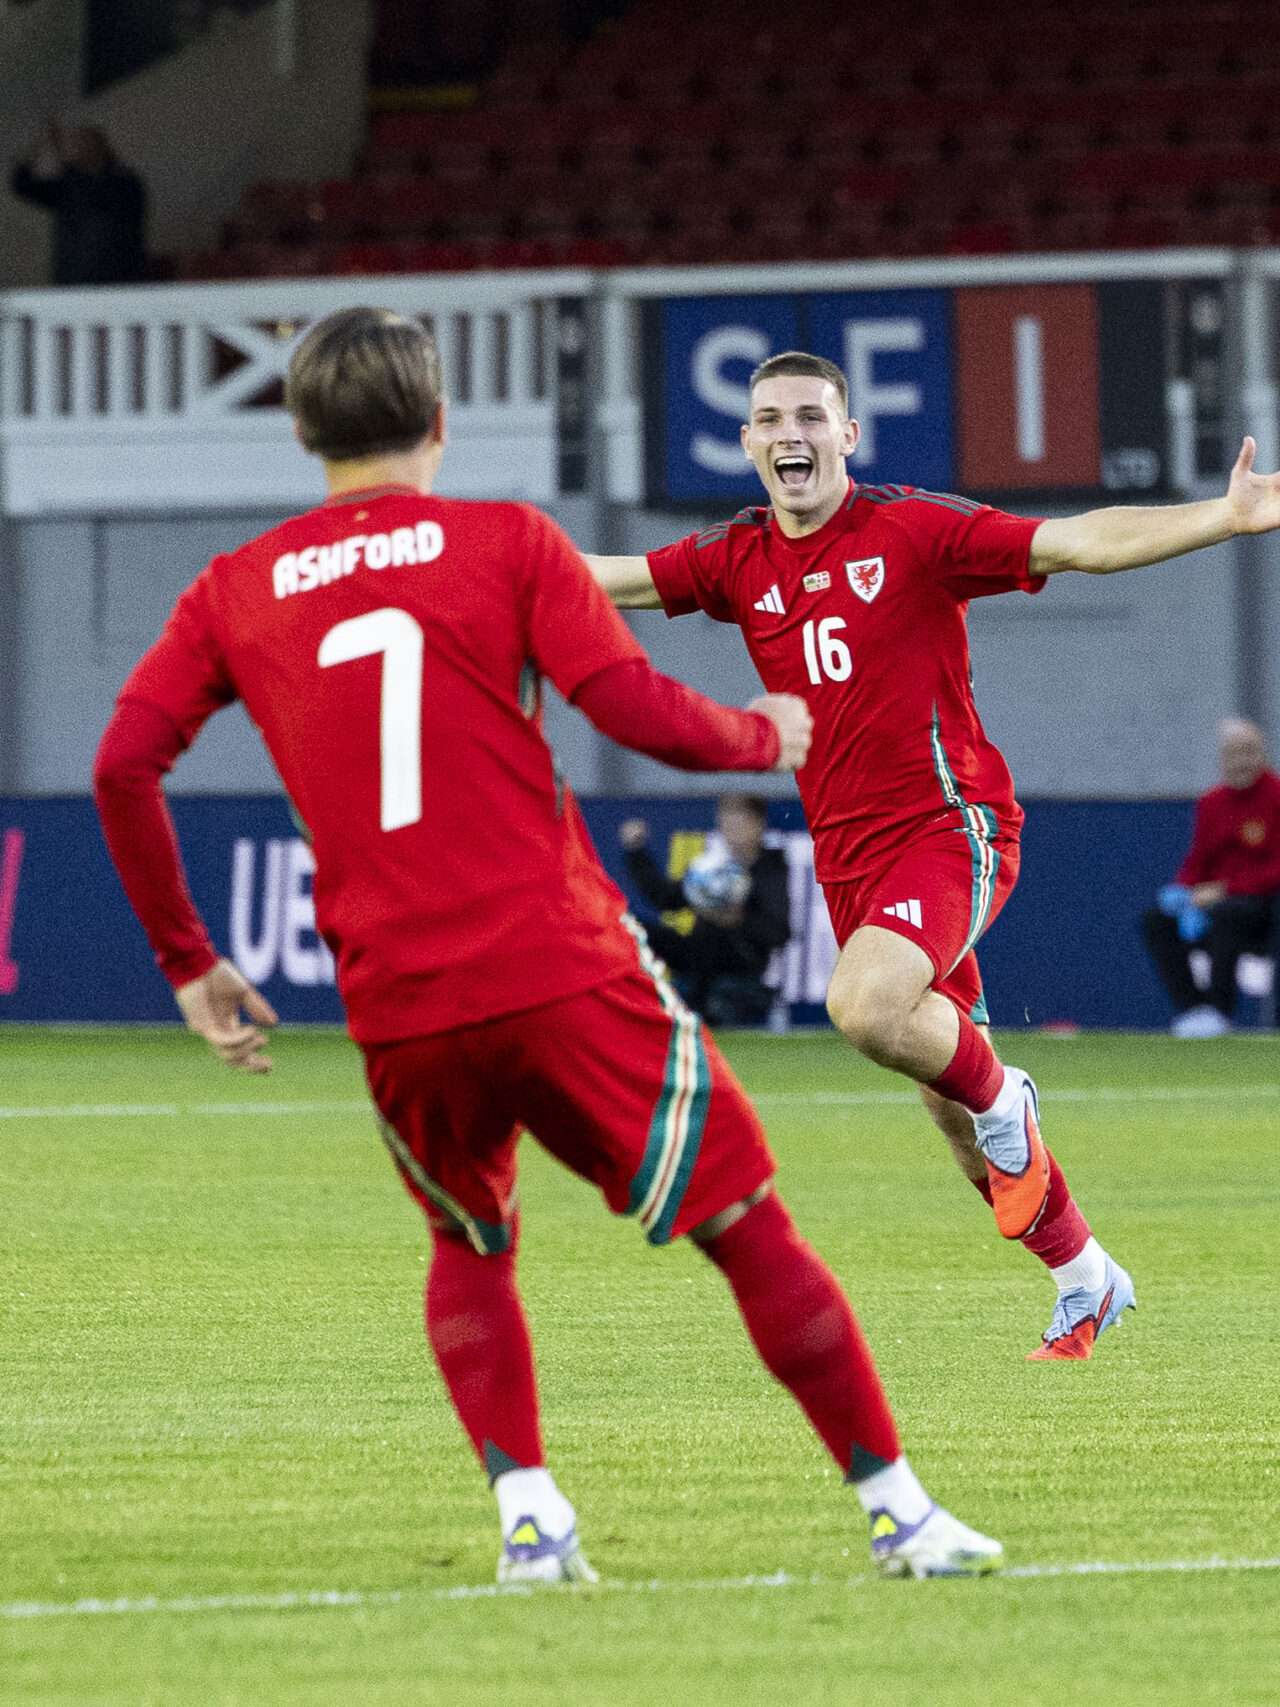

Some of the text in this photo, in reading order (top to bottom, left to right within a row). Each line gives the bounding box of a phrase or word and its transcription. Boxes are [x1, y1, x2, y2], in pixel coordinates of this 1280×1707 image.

[272, 520, 444, 600] ASHFORD
[803, 616, 853, 685] 16
[317, 607, 425, 832] 7
[230, 837, 338, 985] UE
